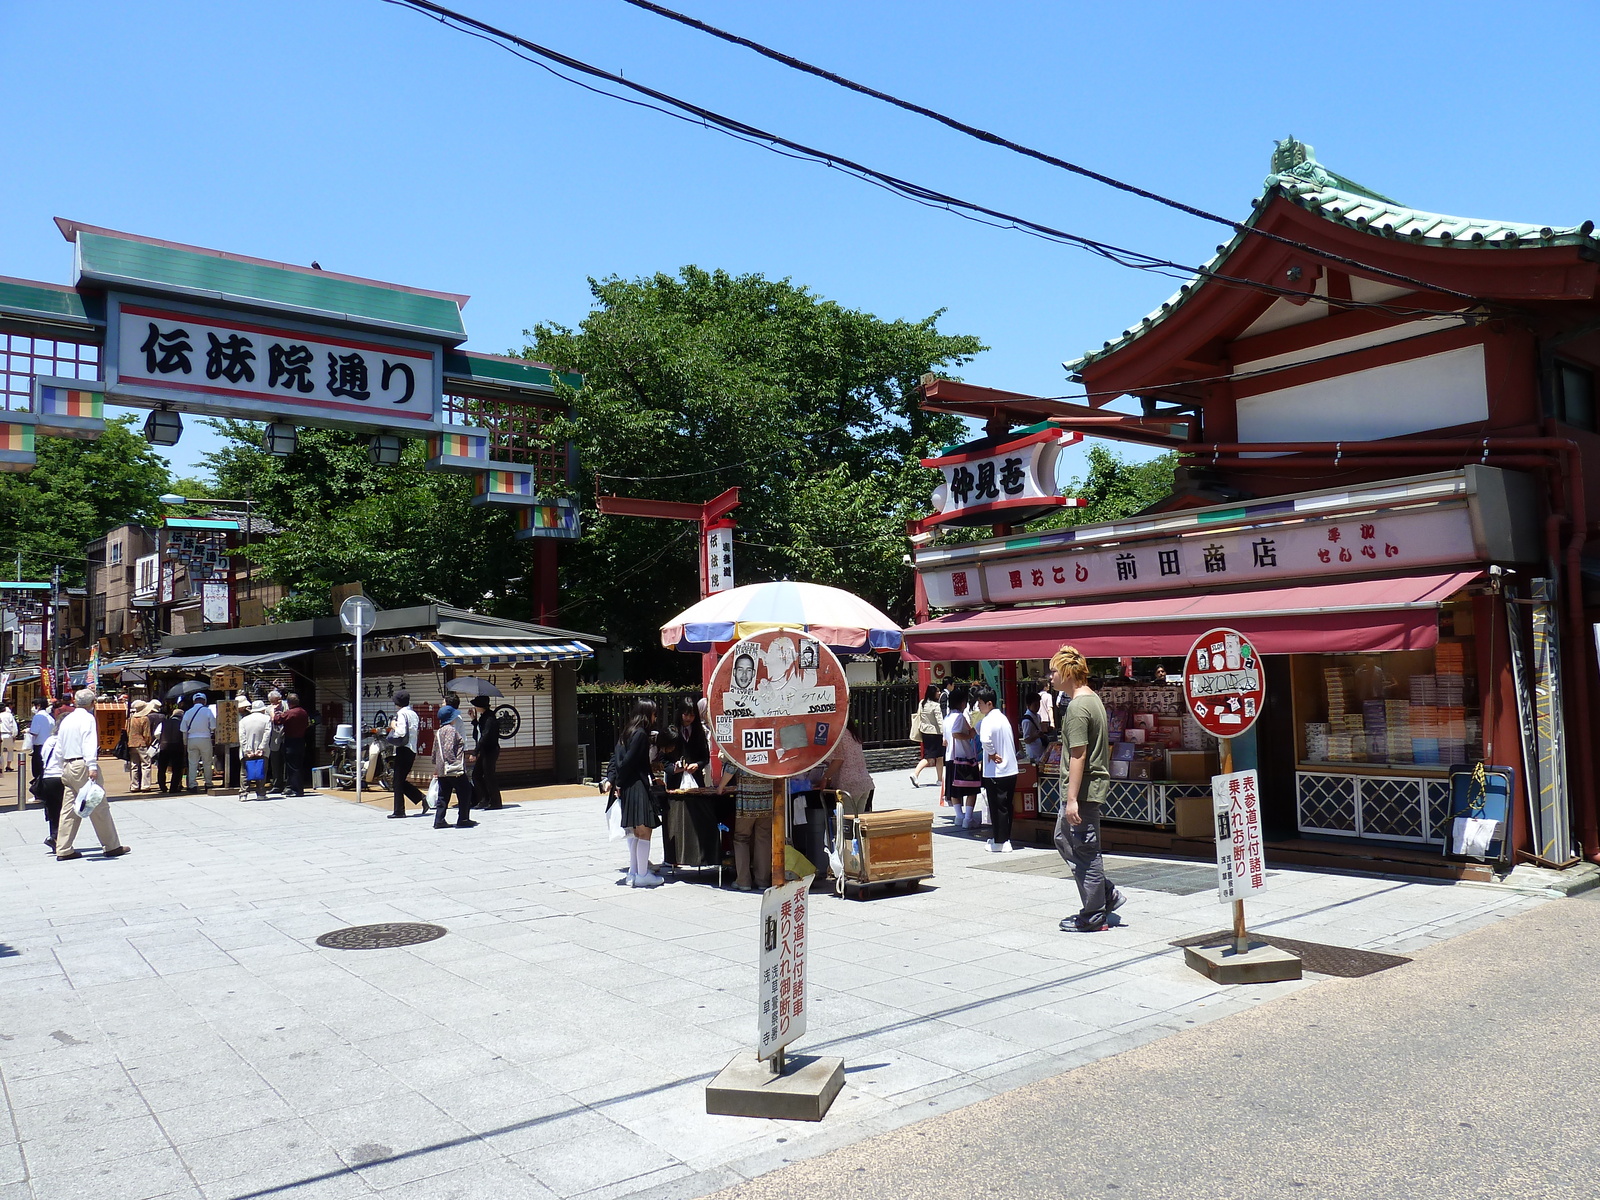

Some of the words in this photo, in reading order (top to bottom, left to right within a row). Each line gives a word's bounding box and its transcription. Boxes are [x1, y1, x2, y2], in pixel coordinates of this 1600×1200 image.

[140, 322, 416, 405] 伝法院通り
[172, 532, 228, 569] 伝法院通り
[709, 534, 719, 587] 伝法院
[1115, 537, 1278, 581] 前田商店
[1317, 543, 1399, 564] せんべい
[228, 669, 238, 688] 下馬
[107, 712, 115, 745] 江戸切子
[744, 731, 773, 748] BNE
[1228, 778, 1246, 878] 乗入れお断り
[1242, 776, 1263, 889] 表参道に付諸車
[779, 900, 792, 1036] 乗り入れ御断り
[792, 885, 807, 1017] 表参道に付諸車
[762, 968, 771, 1046] 浅草寺
